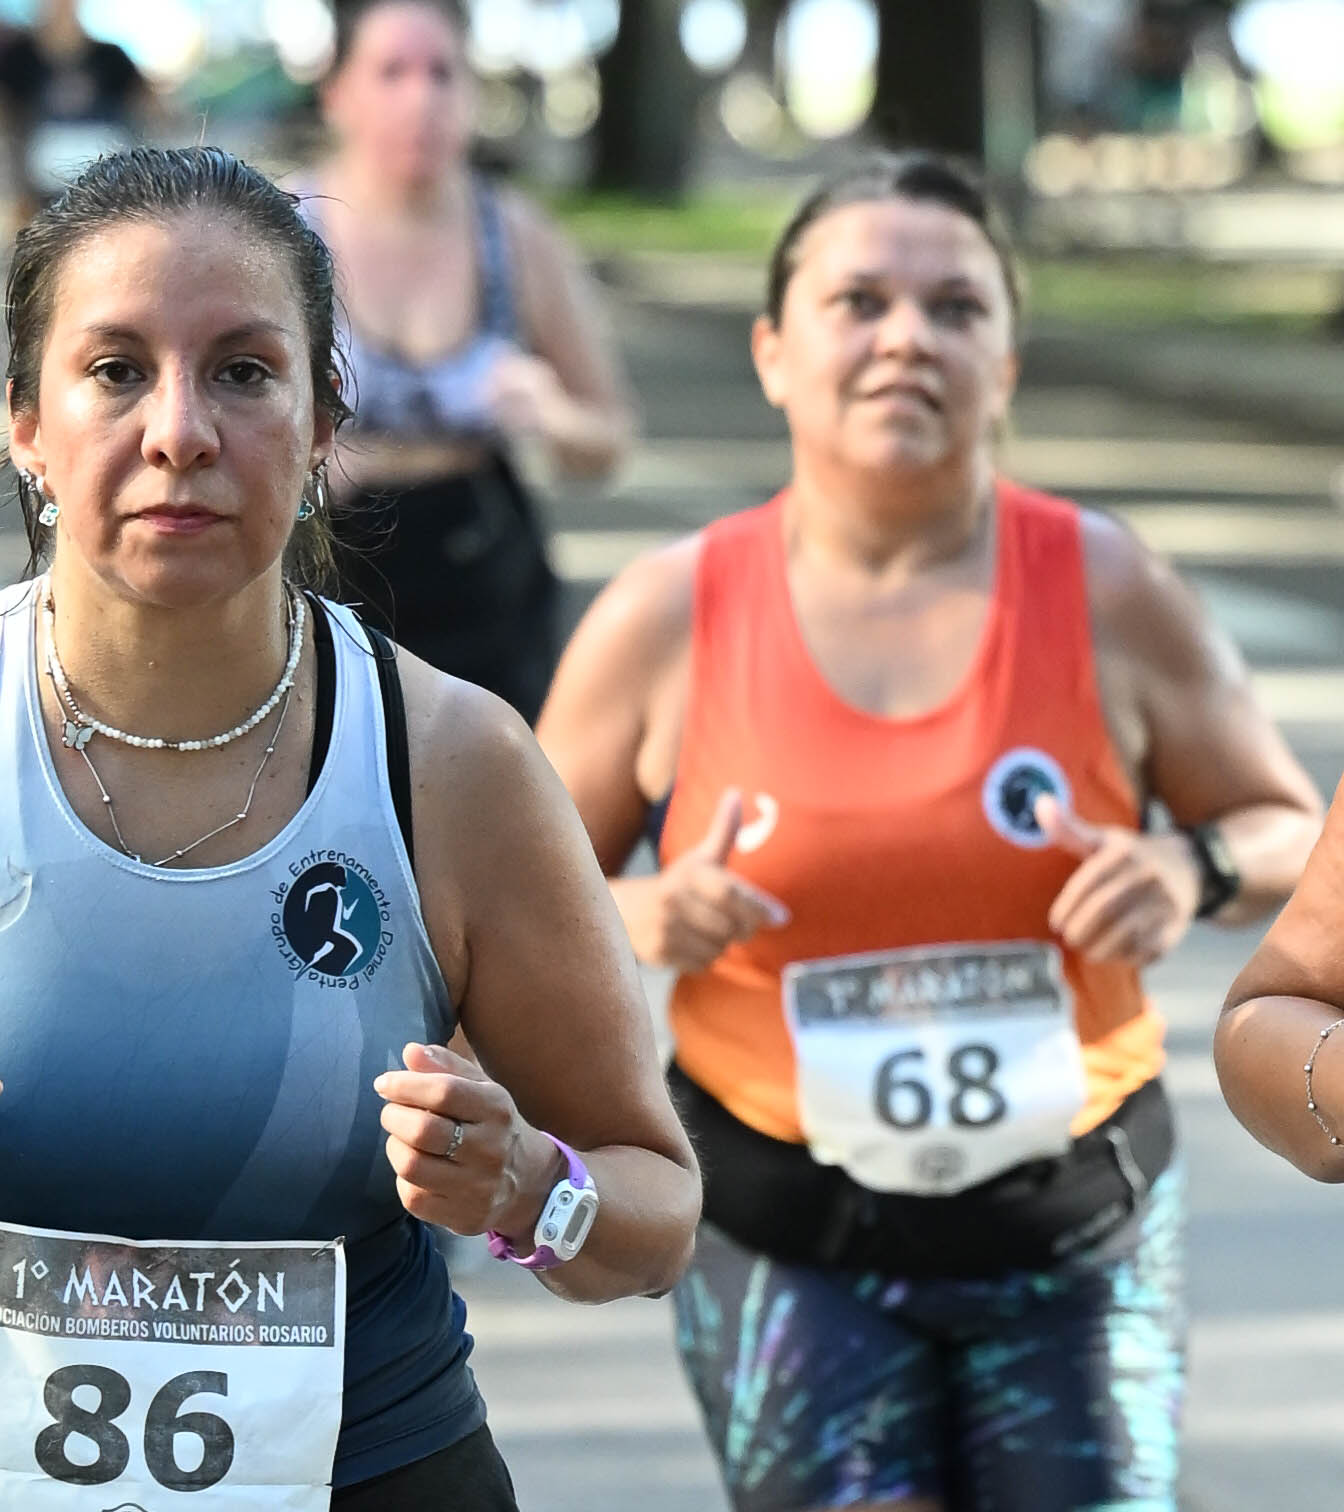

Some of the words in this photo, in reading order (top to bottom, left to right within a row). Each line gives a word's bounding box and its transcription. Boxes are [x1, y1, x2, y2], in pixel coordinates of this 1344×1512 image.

[270, 881, 289, 906] de
[288, 849, 392, 922] Entrenamiento
[270, 913, 303, 971] Grupo
[364, 932, 394, 983] Daniel
[308, 970, 360, 991] Penta
[874, 1043, 1007, 1133] 68
[63, 1259, 285, 1313] MARATÓN
[0, 1308, 60, 1333] CIACIÓN
[66, 1318, 149, 1339] BOMBEROS
[153, 1322, 255, 1344] VOLUNTARIOS
[259, 1325, 327, 1345] ROSARIO
[34, 1364, 235, 1492] 86
